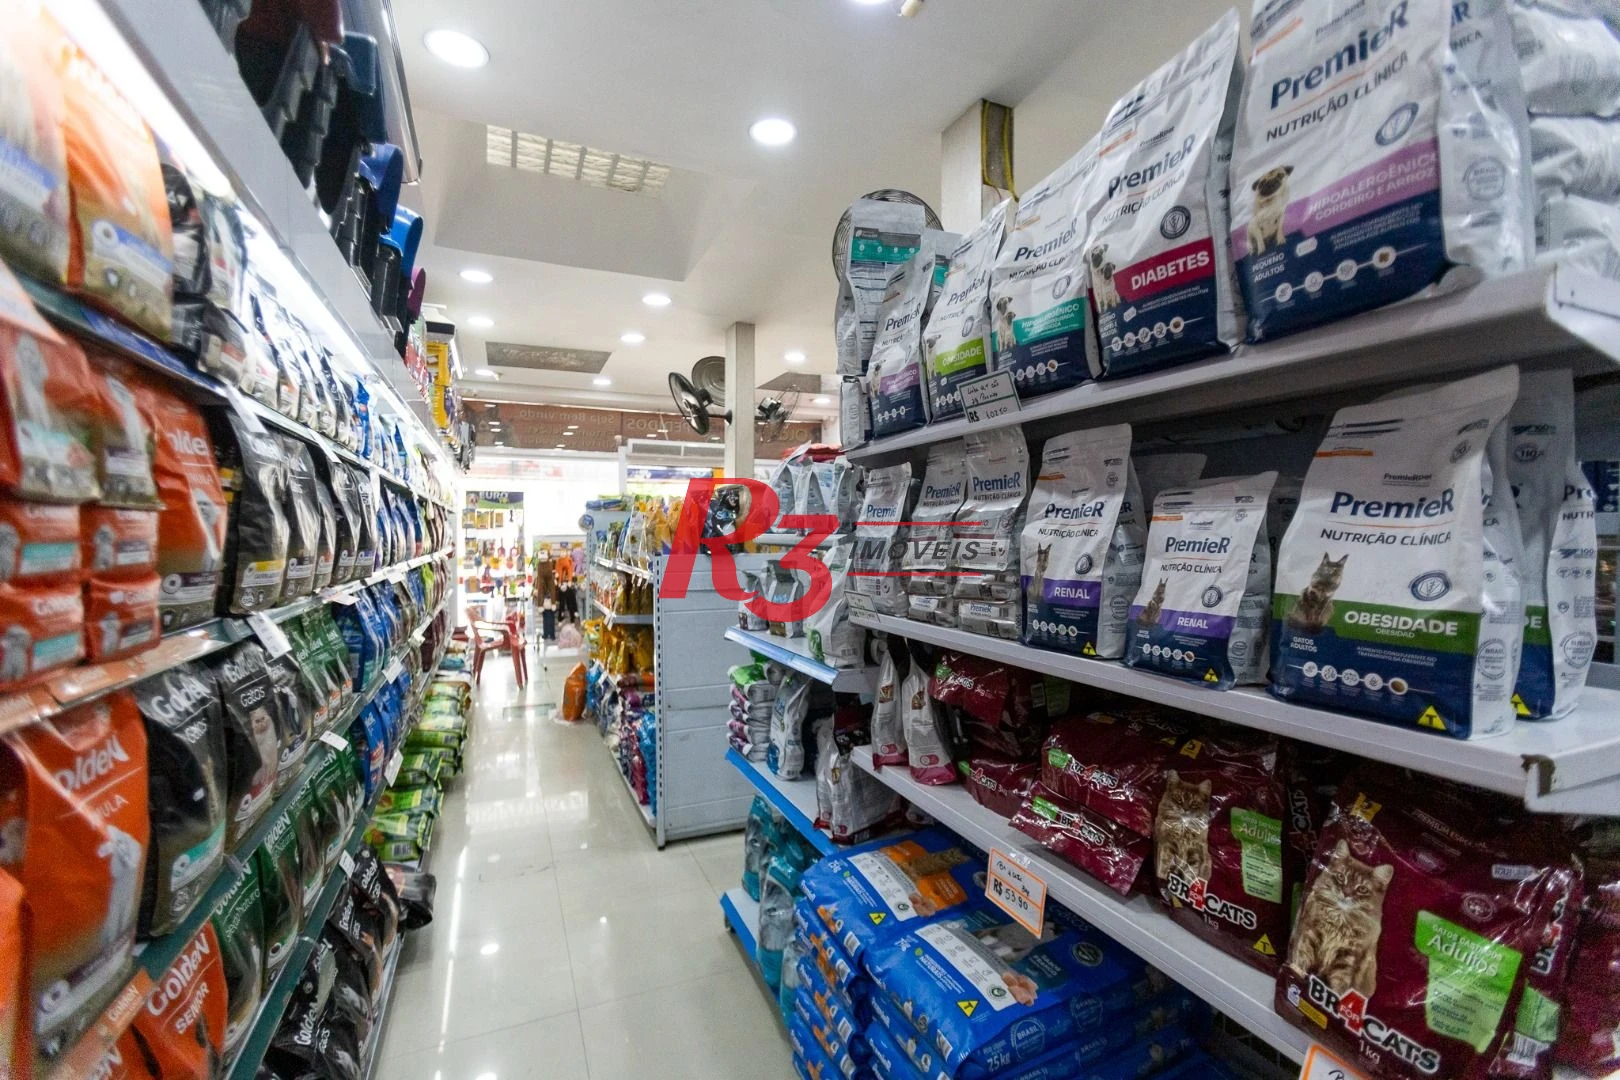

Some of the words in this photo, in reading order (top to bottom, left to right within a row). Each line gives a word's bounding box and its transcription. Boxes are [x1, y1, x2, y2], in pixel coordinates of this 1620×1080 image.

[1266, 93, 1349, 142] NUTRIÇÃO
[1353, 50, 1409, 101] CLÍNICA
[1131, 251, 1210, 291] DIABETES
[973, 471, 1021, 492] PremieR
[1330, 487, 1454, 519] PremieR
[1165, 537, 1230, 554] PremieR
[1320, 528, 1397, 546] NUTRIÇÃO
[1400, 529, 1451, 546] CLÍNICA
[1160, 563, 1192, 572] NUTRIÇÃO
[1194, 564, 1222, 573] CLÍNICA
[1054, 587, 1090, 599] RENAL
[1177, 616, 1209, 629] RENAL
[1344, 610, 1459, 637] OBESIDADE
[1375, 627, 1415, 639] OBESIDAD
[240, 686, 265, 708] Gatos
[993, 878, 1003, 896] R$
[1427, 934, 1498, 977] Adultos
[147, 932, 211, 1017] GoldeN
[175, 982, 210, 1035] SENIOR
[1016, 1024, 1038, 1040] BRASIL
[1359, 1040, 1380, 1064] 1kg
